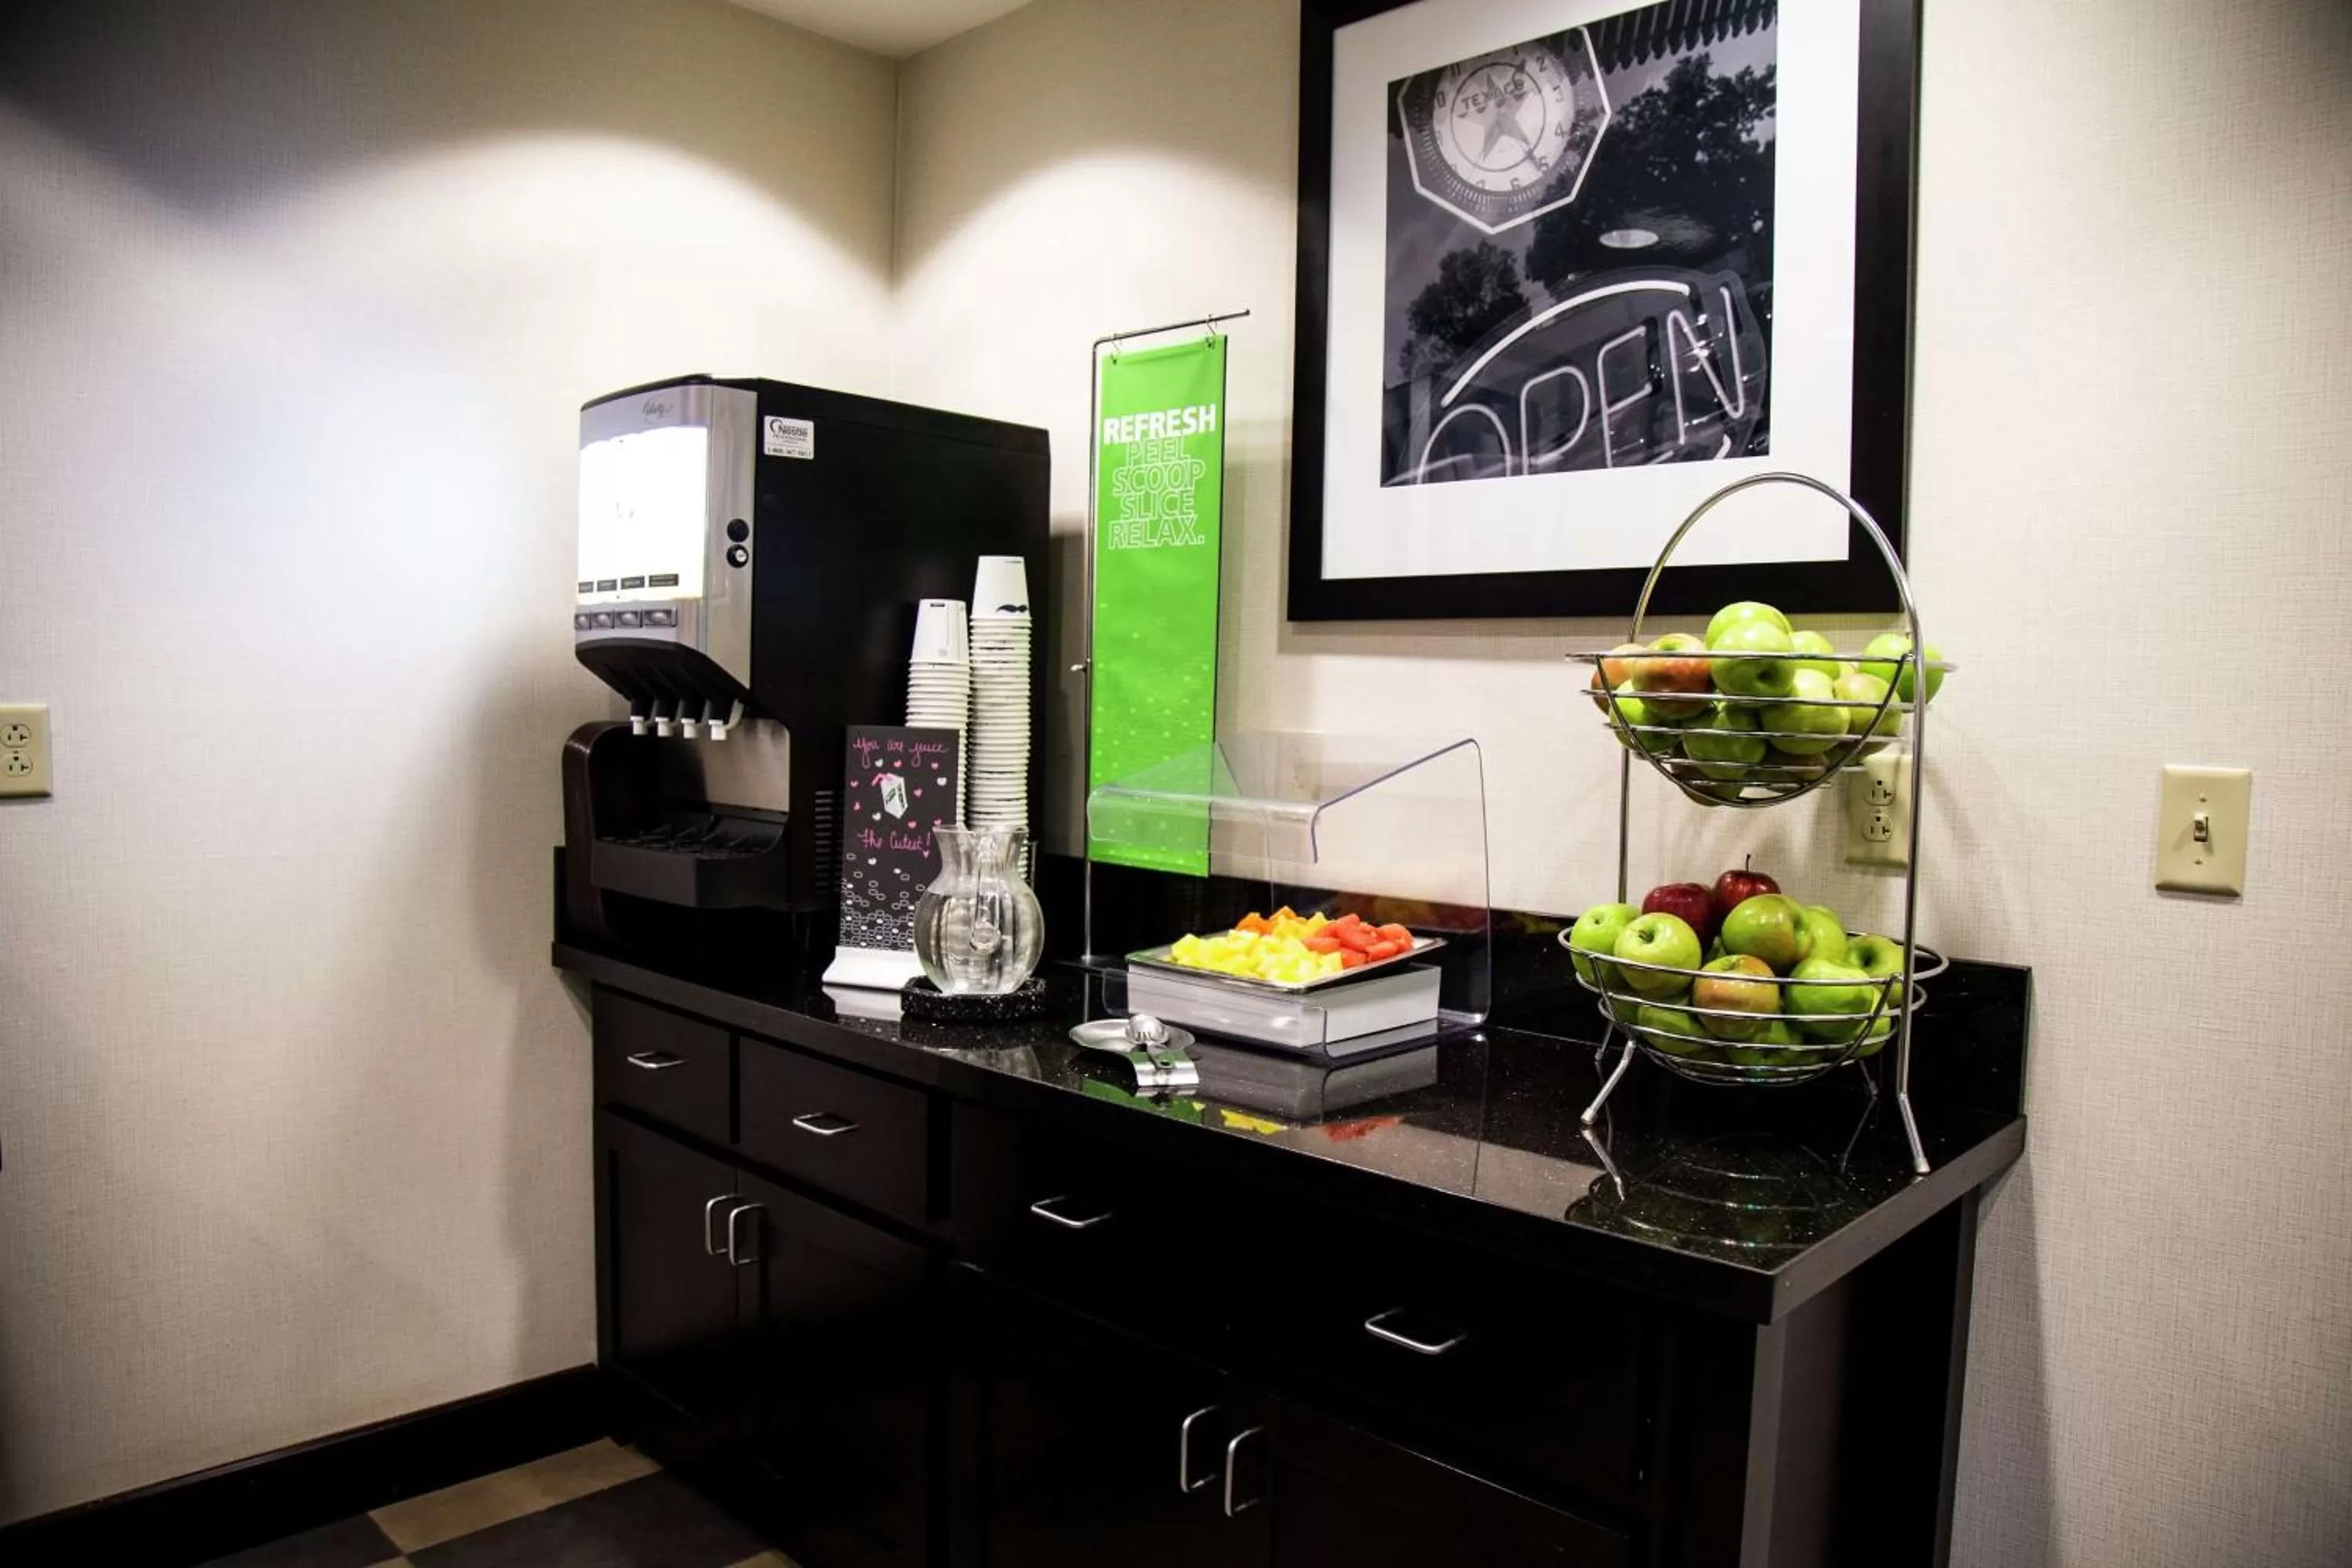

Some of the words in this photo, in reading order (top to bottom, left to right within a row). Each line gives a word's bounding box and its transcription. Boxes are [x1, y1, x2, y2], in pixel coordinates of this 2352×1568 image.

[1461, 79, 1525, 110] TEXACO
[1554, 122, 1568, 139] 4
[1416, 285, 1745, 485] OPEN
[1103, 403, 1216, 445] REFRESH
[1127, 435, 1190, 466] PEEL
[1112, 459, 1205, 496] SCOOP
[1120, 489, 1195, 521] SLICE
[1109, 514, 1205, 550] RELAX.
